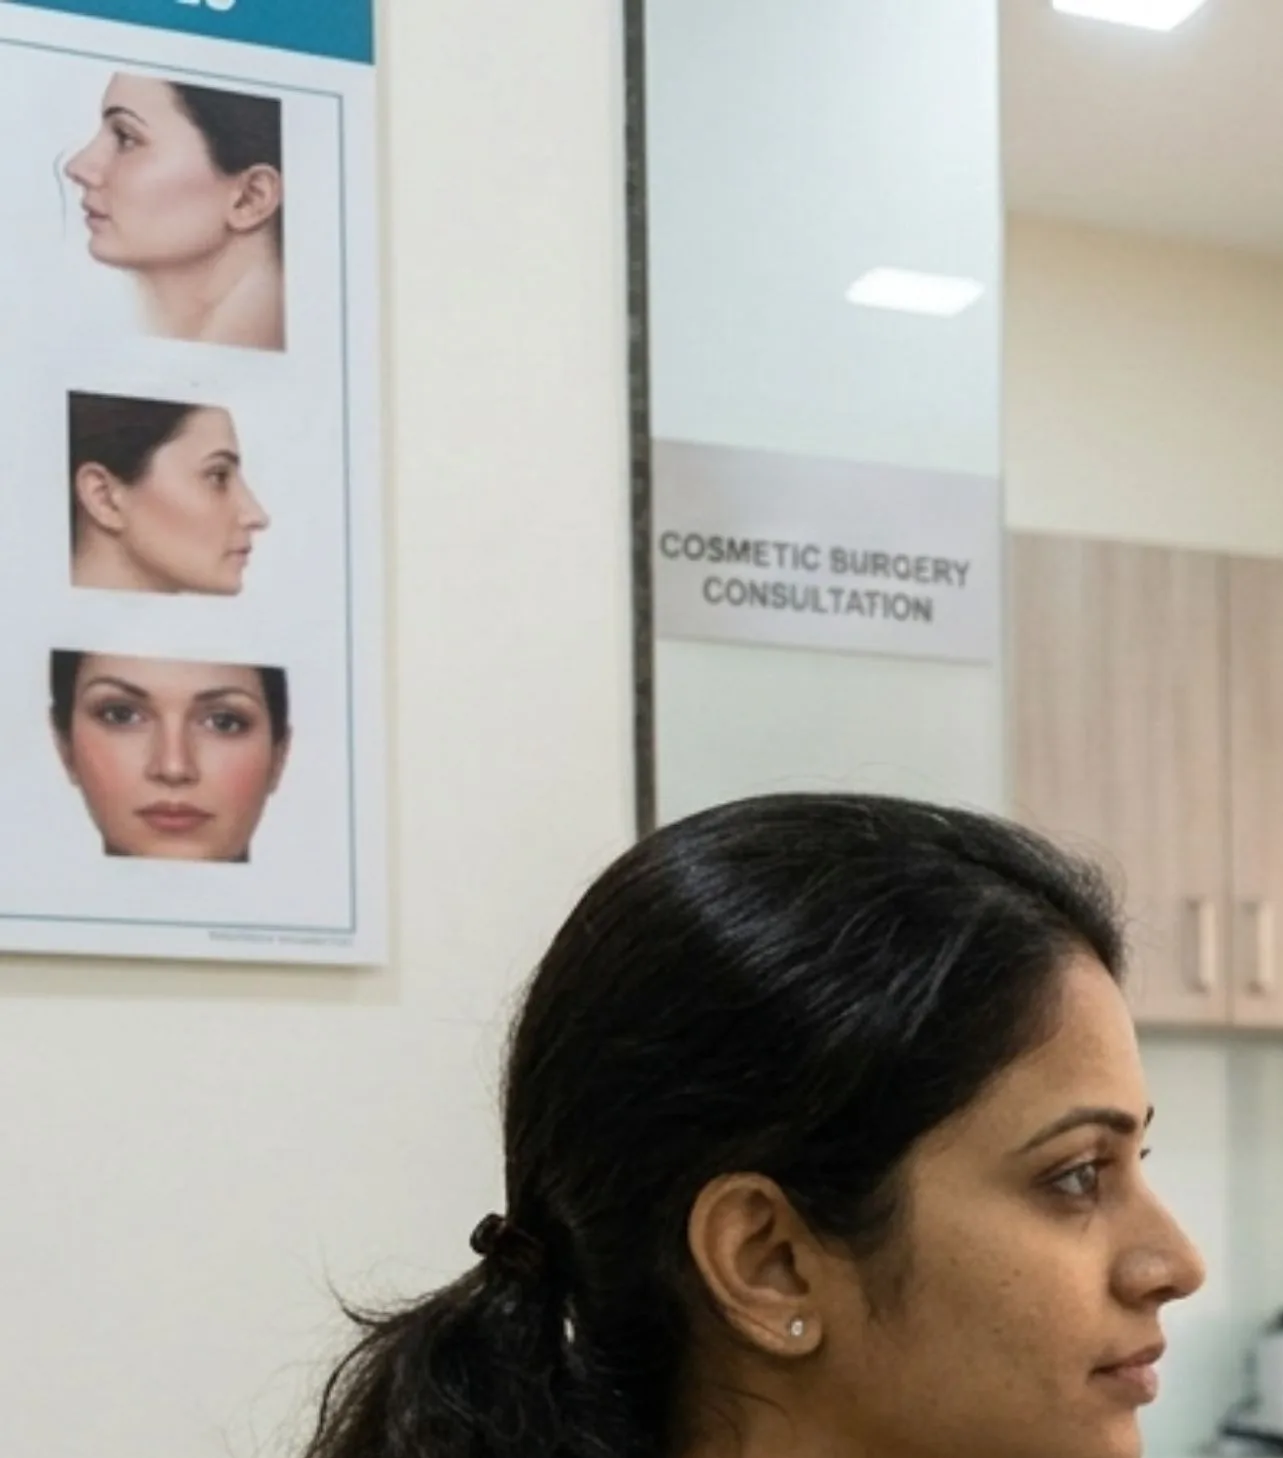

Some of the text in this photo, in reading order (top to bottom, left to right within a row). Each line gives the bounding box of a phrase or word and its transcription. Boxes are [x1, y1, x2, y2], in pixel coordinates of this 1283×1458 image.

[659, 531, 971, 587] COSMETIC SURGERY
[702, 576, 934, 622] CONSULTATION
